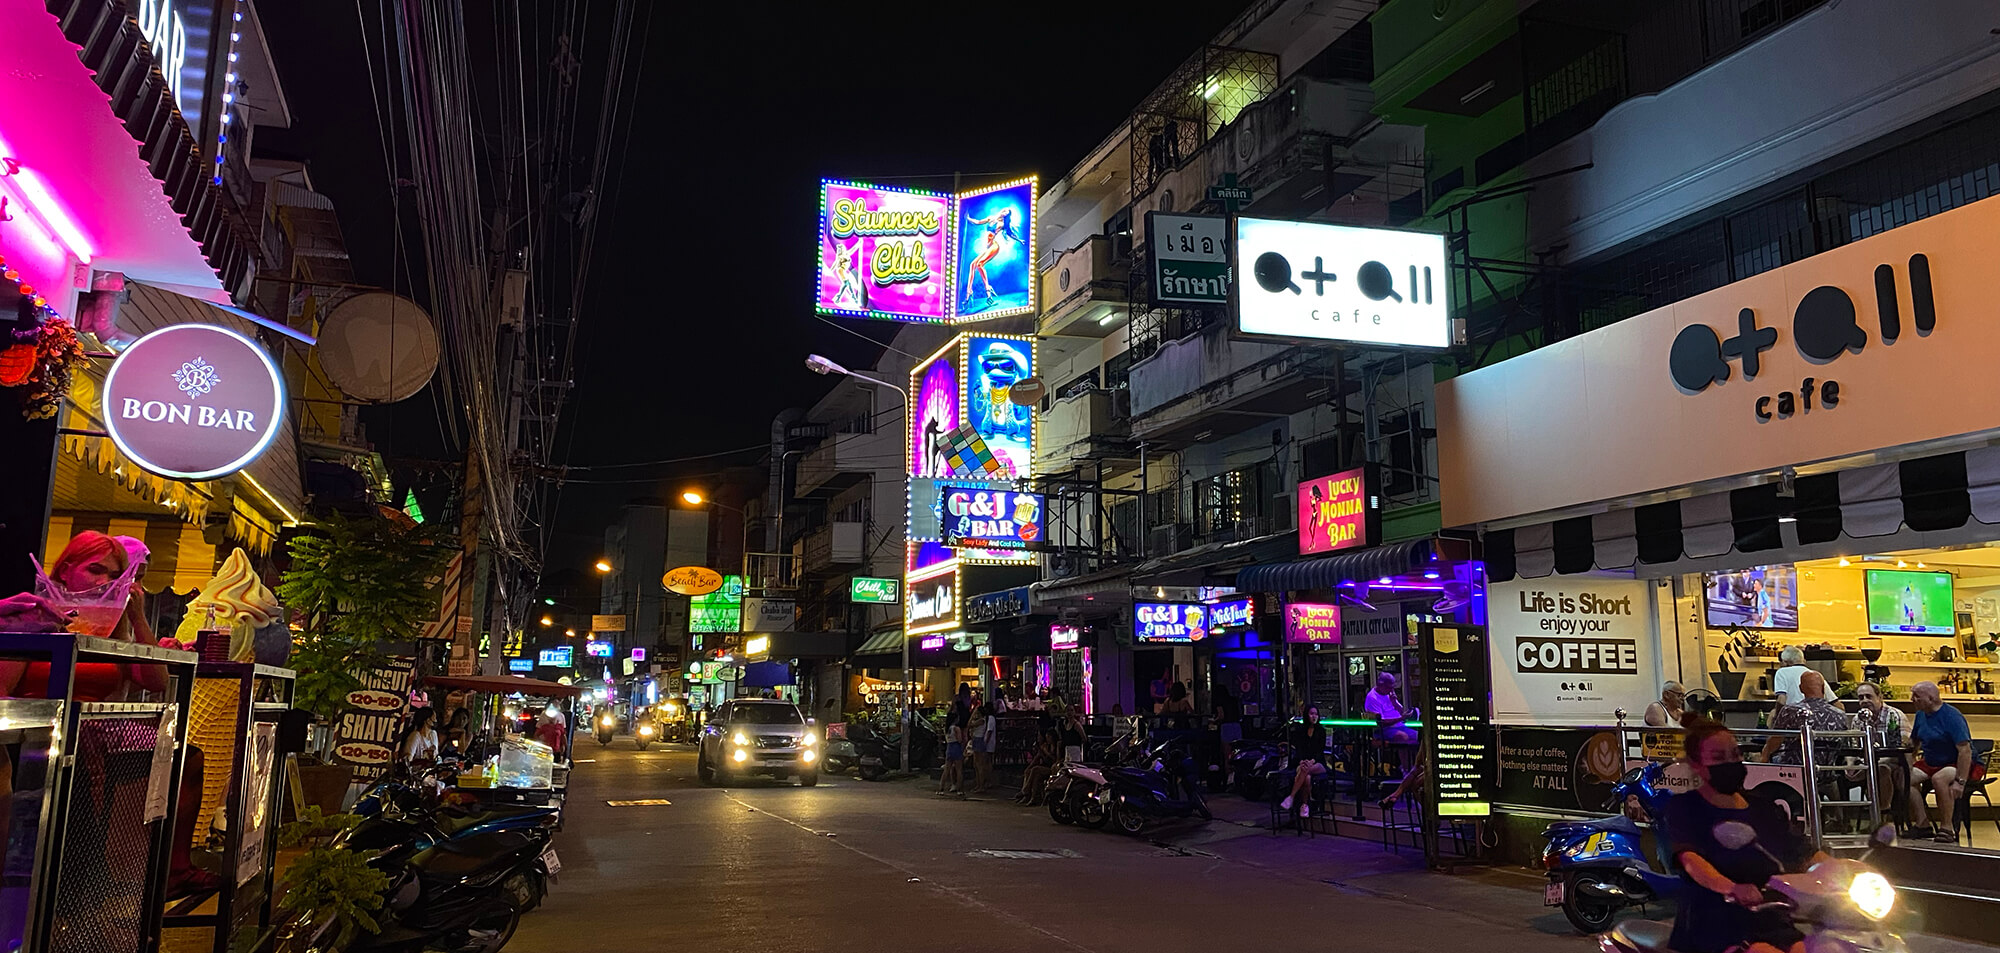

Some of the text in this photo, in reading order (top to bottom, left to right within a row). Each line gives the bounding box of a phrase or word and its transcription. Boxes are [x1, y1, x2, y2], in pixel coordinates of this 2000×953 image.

[833, 198, 939, 236] Stunners
[872, 240, 928, 282] Club
[1311, 309, 1381, 325] cafe
[1755, 377, 1840, 422] cafe
[122, 398, 257, 432] BON BAR
[948, 492, 1006, 519] G&J
[971, 520, 1014, 537] BAR
[989, 539, 999, 547] And
[669, 575, 716, 588] Beach Bar
[855, 580, 881, 593] Chill
[877, 591, 896, 602] Inn
[1520, 591, 1631, 615] Life is Short
[1138, 605, 1178, 624] G&J
[1154, 624, 1185, 636] BAR
[1343, 619, 1368, 636] PATTAYA
[1540, 615, 1610, 635] enjoy your
[1517, 641, 1637, 669] COFFEE
[350, 693, 400, 708] 120-150
[341, 713, 398, 743] SHAVE
[340, 746, 390, 760] 120-150
[1500, 746, 1516, 755] After
[1522, 748, 1535, 758] cup
[1536, 747, 1543, 756] of
[1500, 760, 1568, 773] Nothing else matters
[1533, 775, 1568, 790] AT ALL
